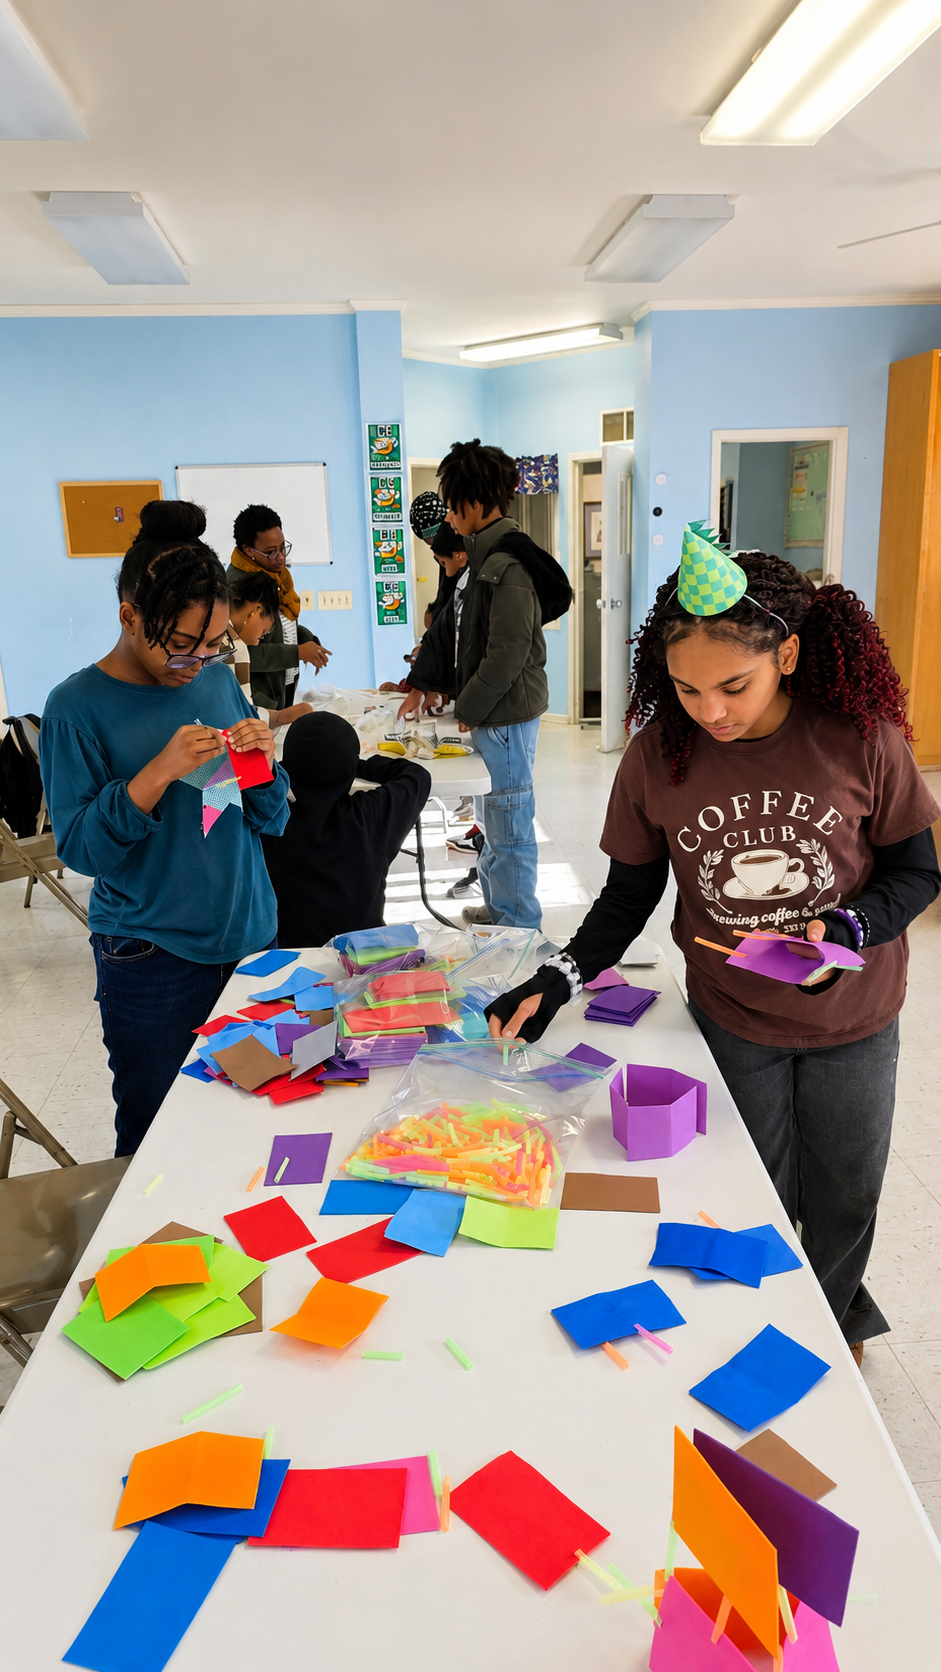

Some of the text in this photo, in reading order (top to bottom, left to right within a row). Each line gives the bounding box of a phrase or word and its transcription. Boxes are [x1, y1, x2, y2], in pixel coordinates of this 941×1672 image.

[677, 790, 843, 853] COFFEE
[723, 825, 797, 848] CLUB
[760, 907, 800, 927] coffee
